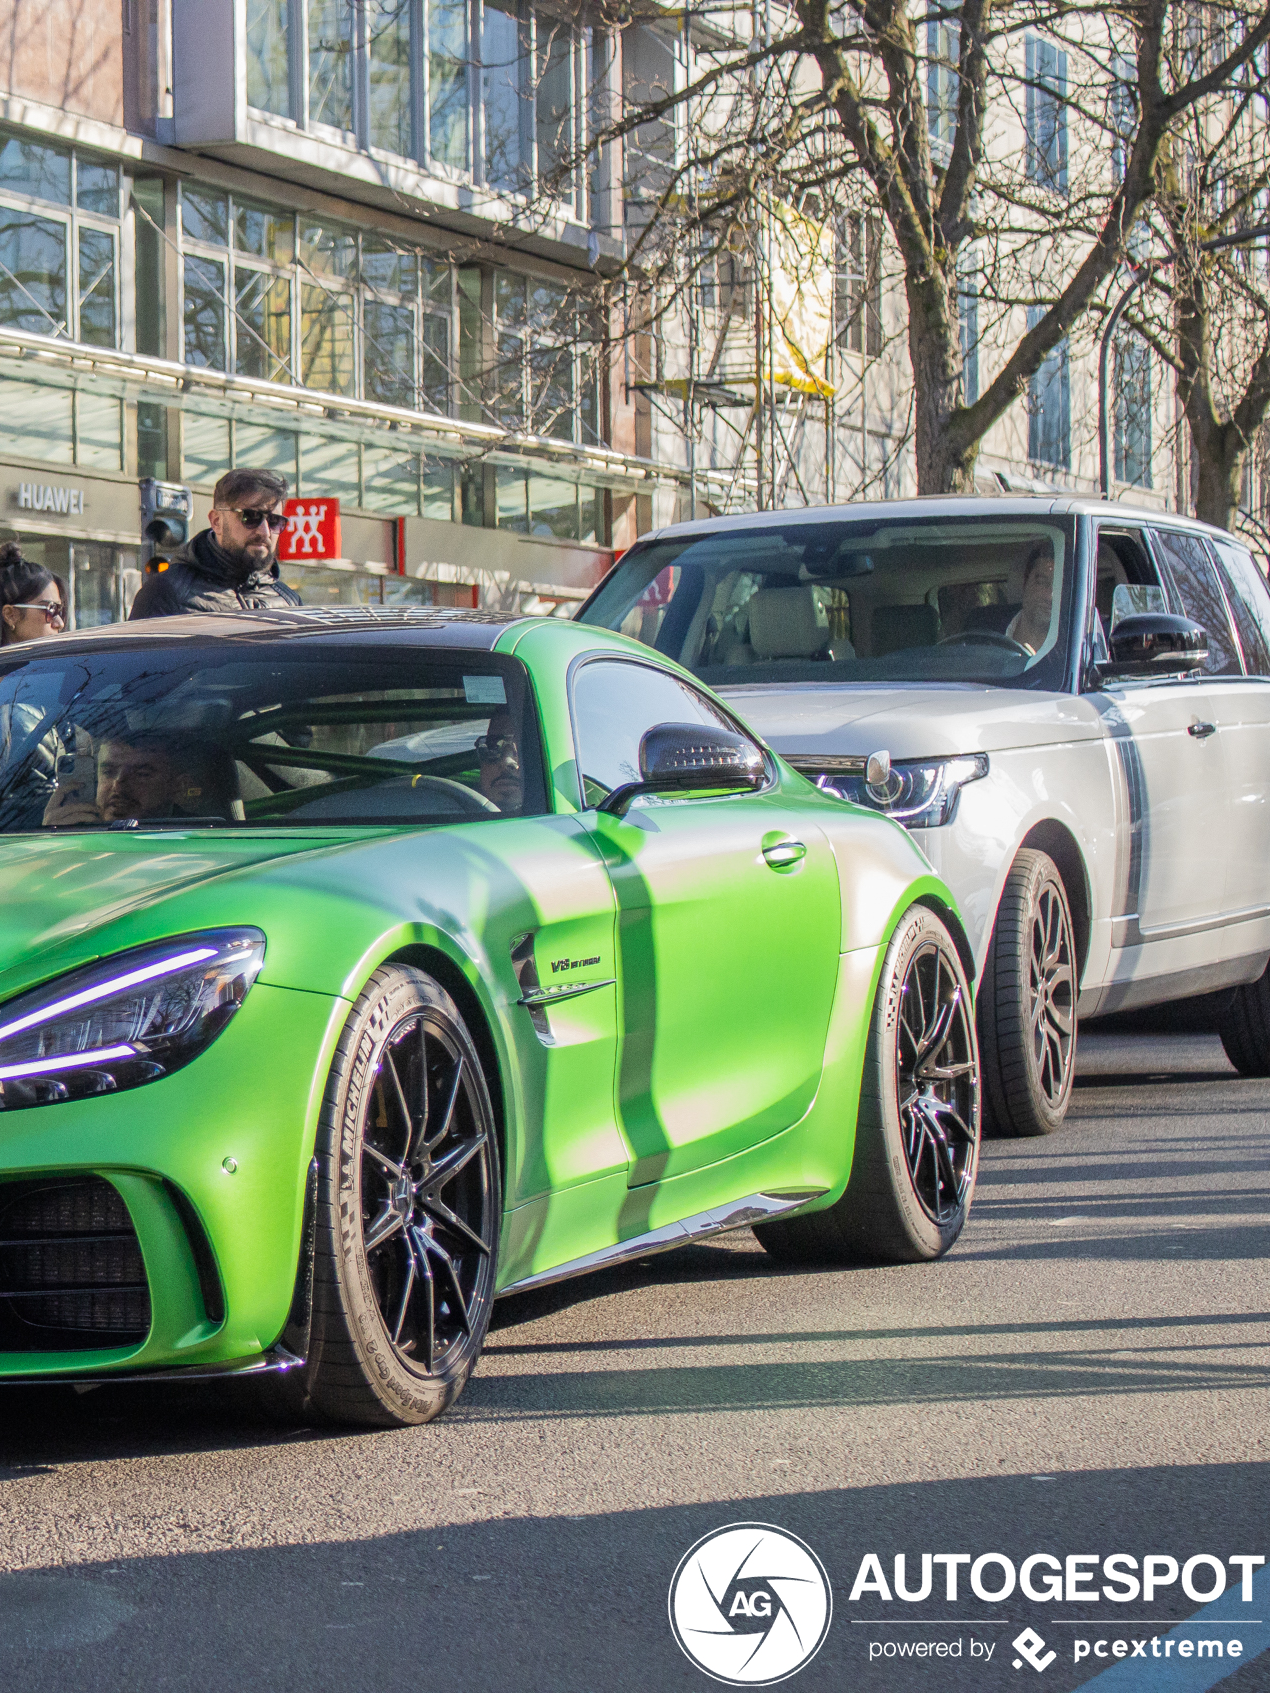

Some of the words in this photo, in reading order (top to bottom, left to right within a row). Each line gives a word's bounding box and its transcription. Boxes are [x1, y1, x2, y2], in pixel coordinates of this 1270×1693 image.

[18, 482, 84, 515] HUAWEI
[342, 1031, 376, 1157] MICHELIN
[386, 1376, 413, 1406] Sport
